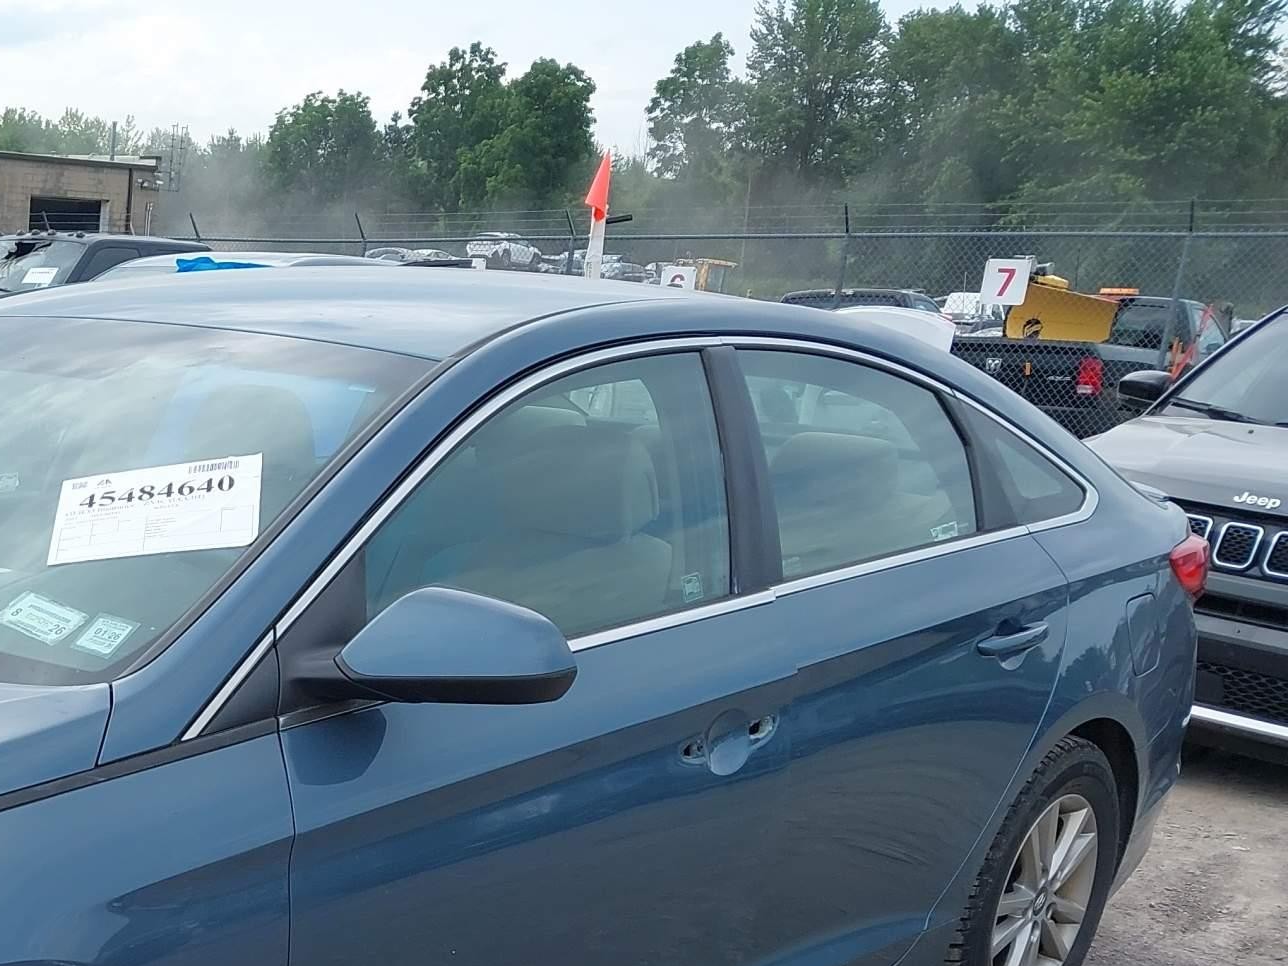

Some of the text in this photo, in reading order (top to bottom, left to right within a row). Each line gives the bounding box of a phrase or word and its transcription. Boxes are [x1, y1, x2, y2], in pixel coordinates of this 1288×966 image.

[997, 268, 1017, 297] 7
[79, 475, 235, 509] 45484640
[1233, 491, 1281, 509] Jeep
[48, 623, 66, 636] 26
